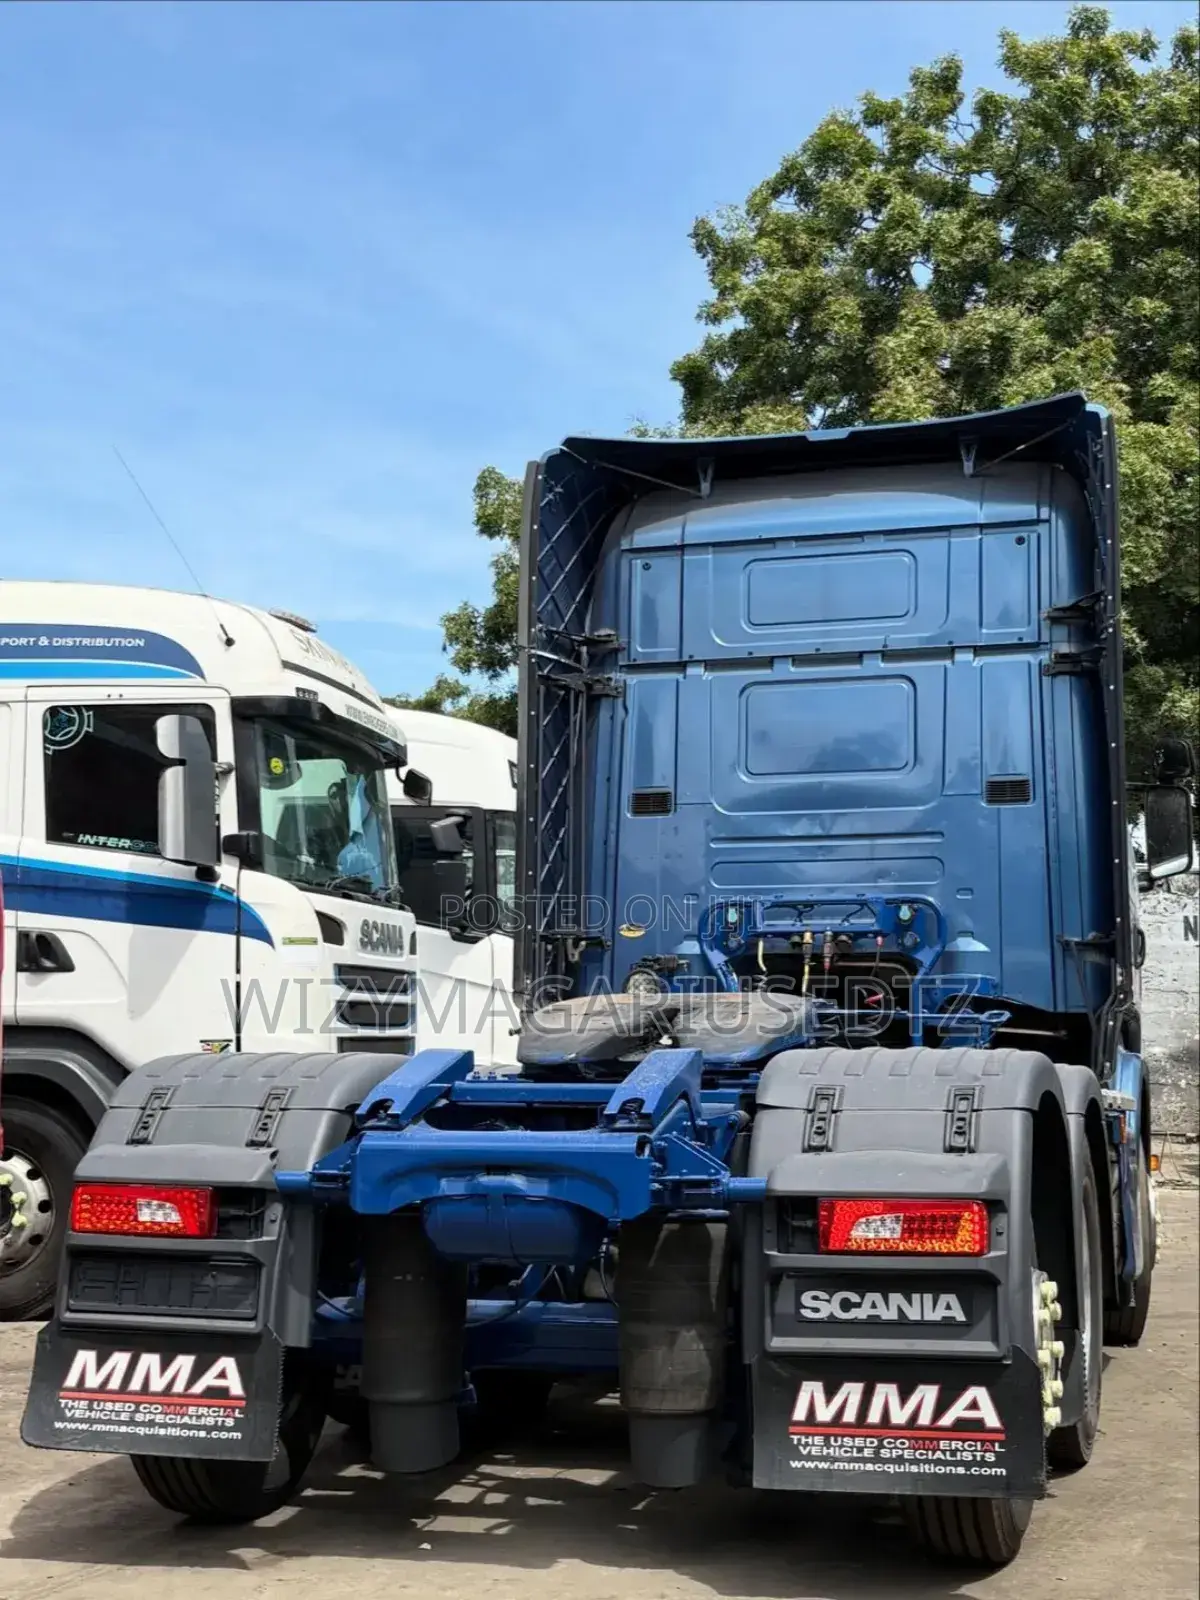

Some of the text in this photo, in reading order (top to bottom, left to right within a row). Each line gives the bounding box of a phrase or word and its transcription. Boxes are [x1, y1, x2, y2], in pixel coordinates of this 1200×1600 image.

[38, 636, 49, 646] &
[52, 638, 145, 647] DISTRIBUTION
[360, 918, 404, 955] SCANIA
[800, 1290, 967, 1321] SCANIA
[62, 1349, 246, 1398] MMA
[59, 1399, 244, 1418] THE USED COMMERCIAL
[791, 1380, 1005, 1430] MMA
[64, 1409, 235, 1426] VEHICLE SPECIALISTS
[54, 1421, 242, 1440] www.mmacquisitions.com
[790, 1435, 1006, 1451] THE USED COMMERCIAL
[798, 1446, 996, 1462] VEHICLE SPECIALISTS
[789, 1459, 1006, 1477] www.mmacquisitions.com
